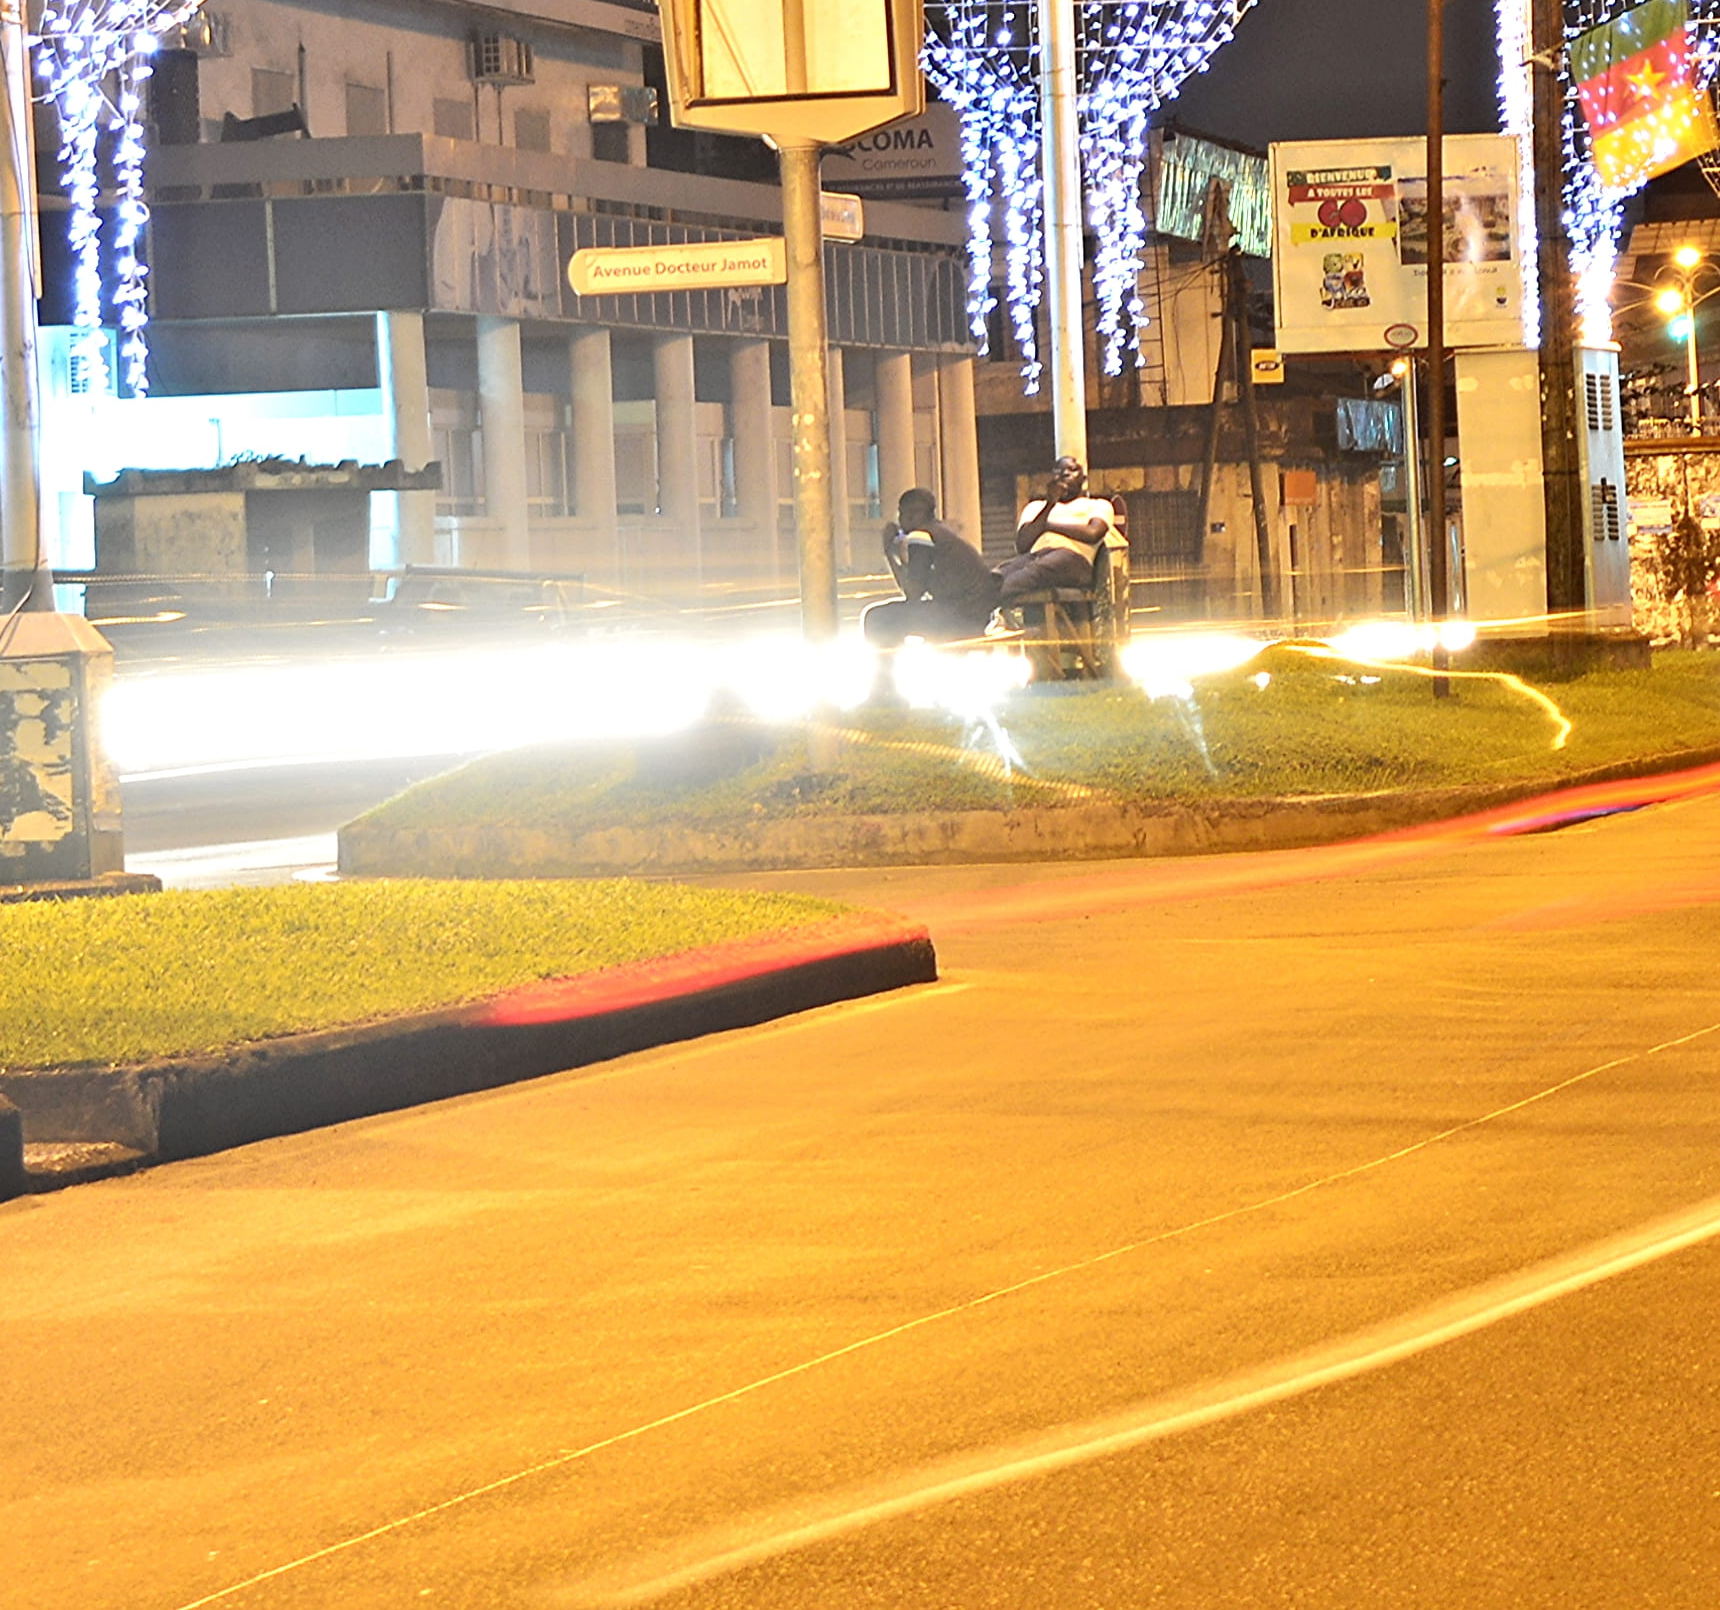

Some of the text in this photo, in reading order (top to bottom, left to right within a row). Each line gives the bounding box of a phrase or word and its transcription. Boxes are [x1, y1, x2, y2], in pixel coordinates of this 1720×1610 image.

[862, 156, 937, 171] Cameroun
[1310, 226, 1375, 239] D'AFRIQUE
[593, 257, 767, 278] Avenue Docteur Jamot
